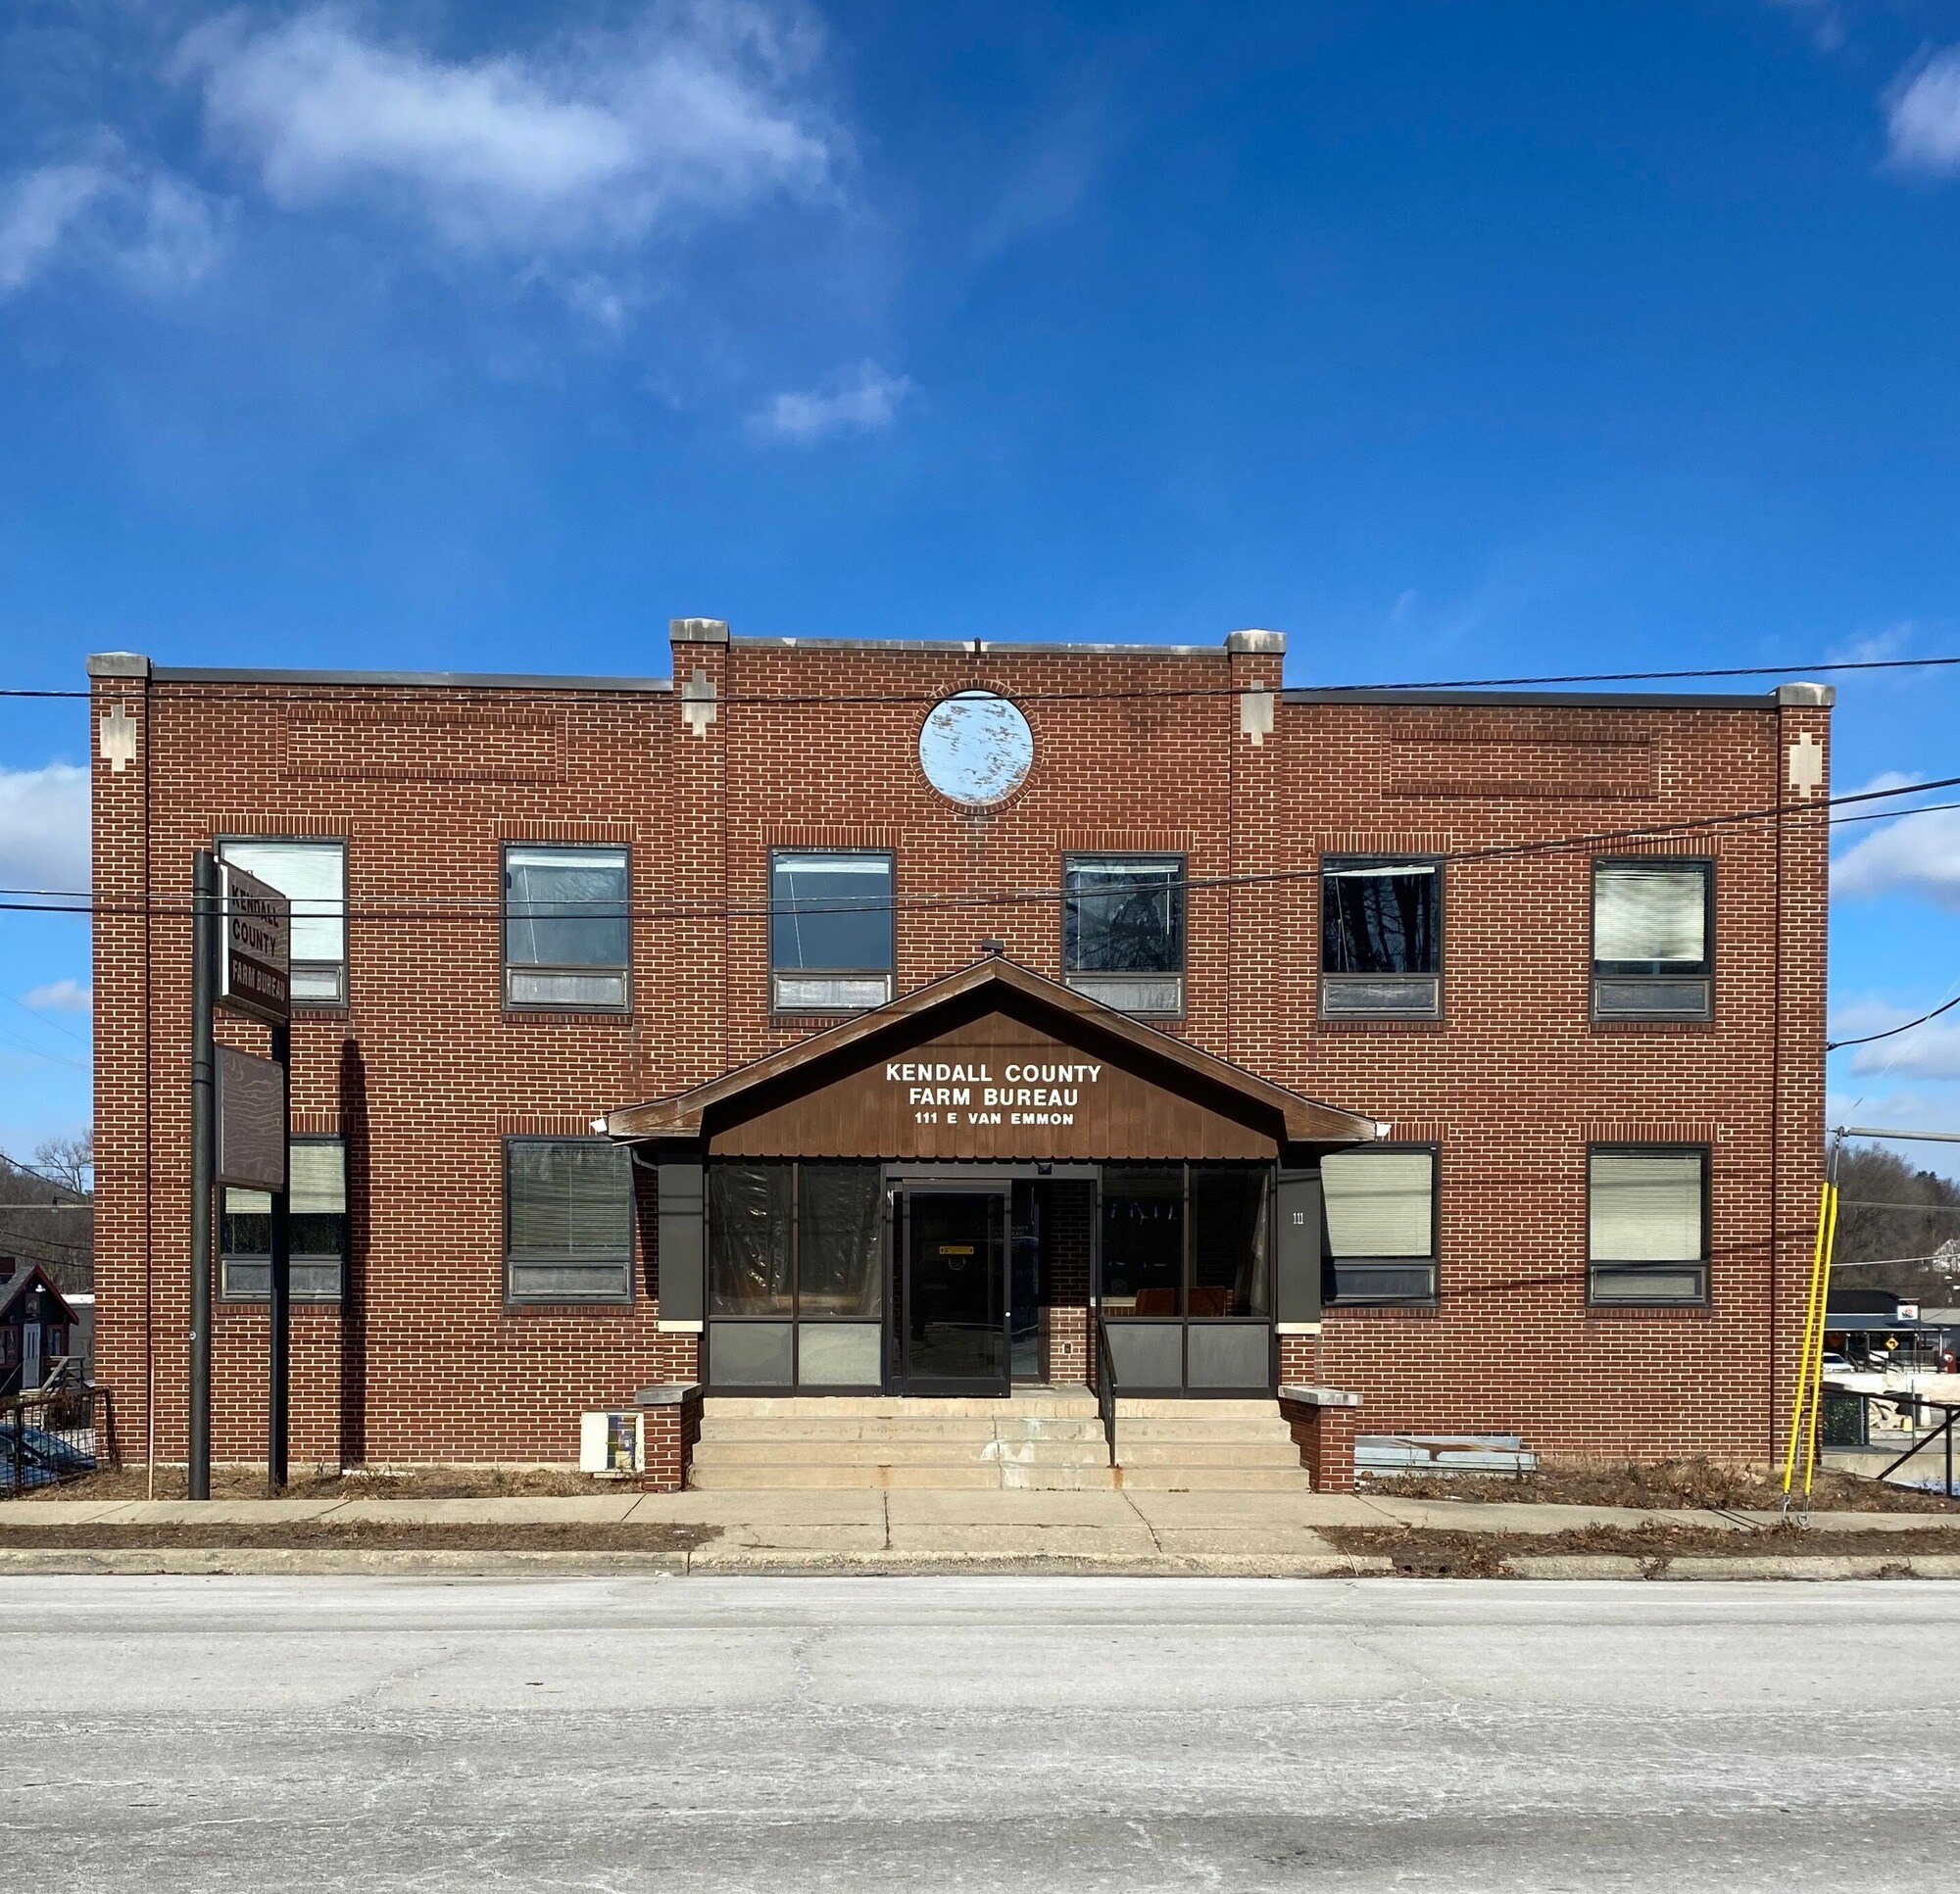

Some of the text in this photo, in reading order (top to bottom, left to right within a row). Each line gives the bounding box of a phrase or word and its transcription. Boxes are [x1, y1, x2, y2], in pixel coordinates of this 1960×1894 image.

[231, 884, 279, 928] KENDALL
[232, 918, 276, 957] COUNTY
[232, 958, 286, 1001] FARM BUREAU
[886, 1063, 1102, 1083] KENDALL COUNTY
[909, 1088, 1078, 1106] FARM BUREAU
[914, 1111, 1074, 1125] 111 E VAN EMMON
[1293, 1212, 1304, 1225] 111
